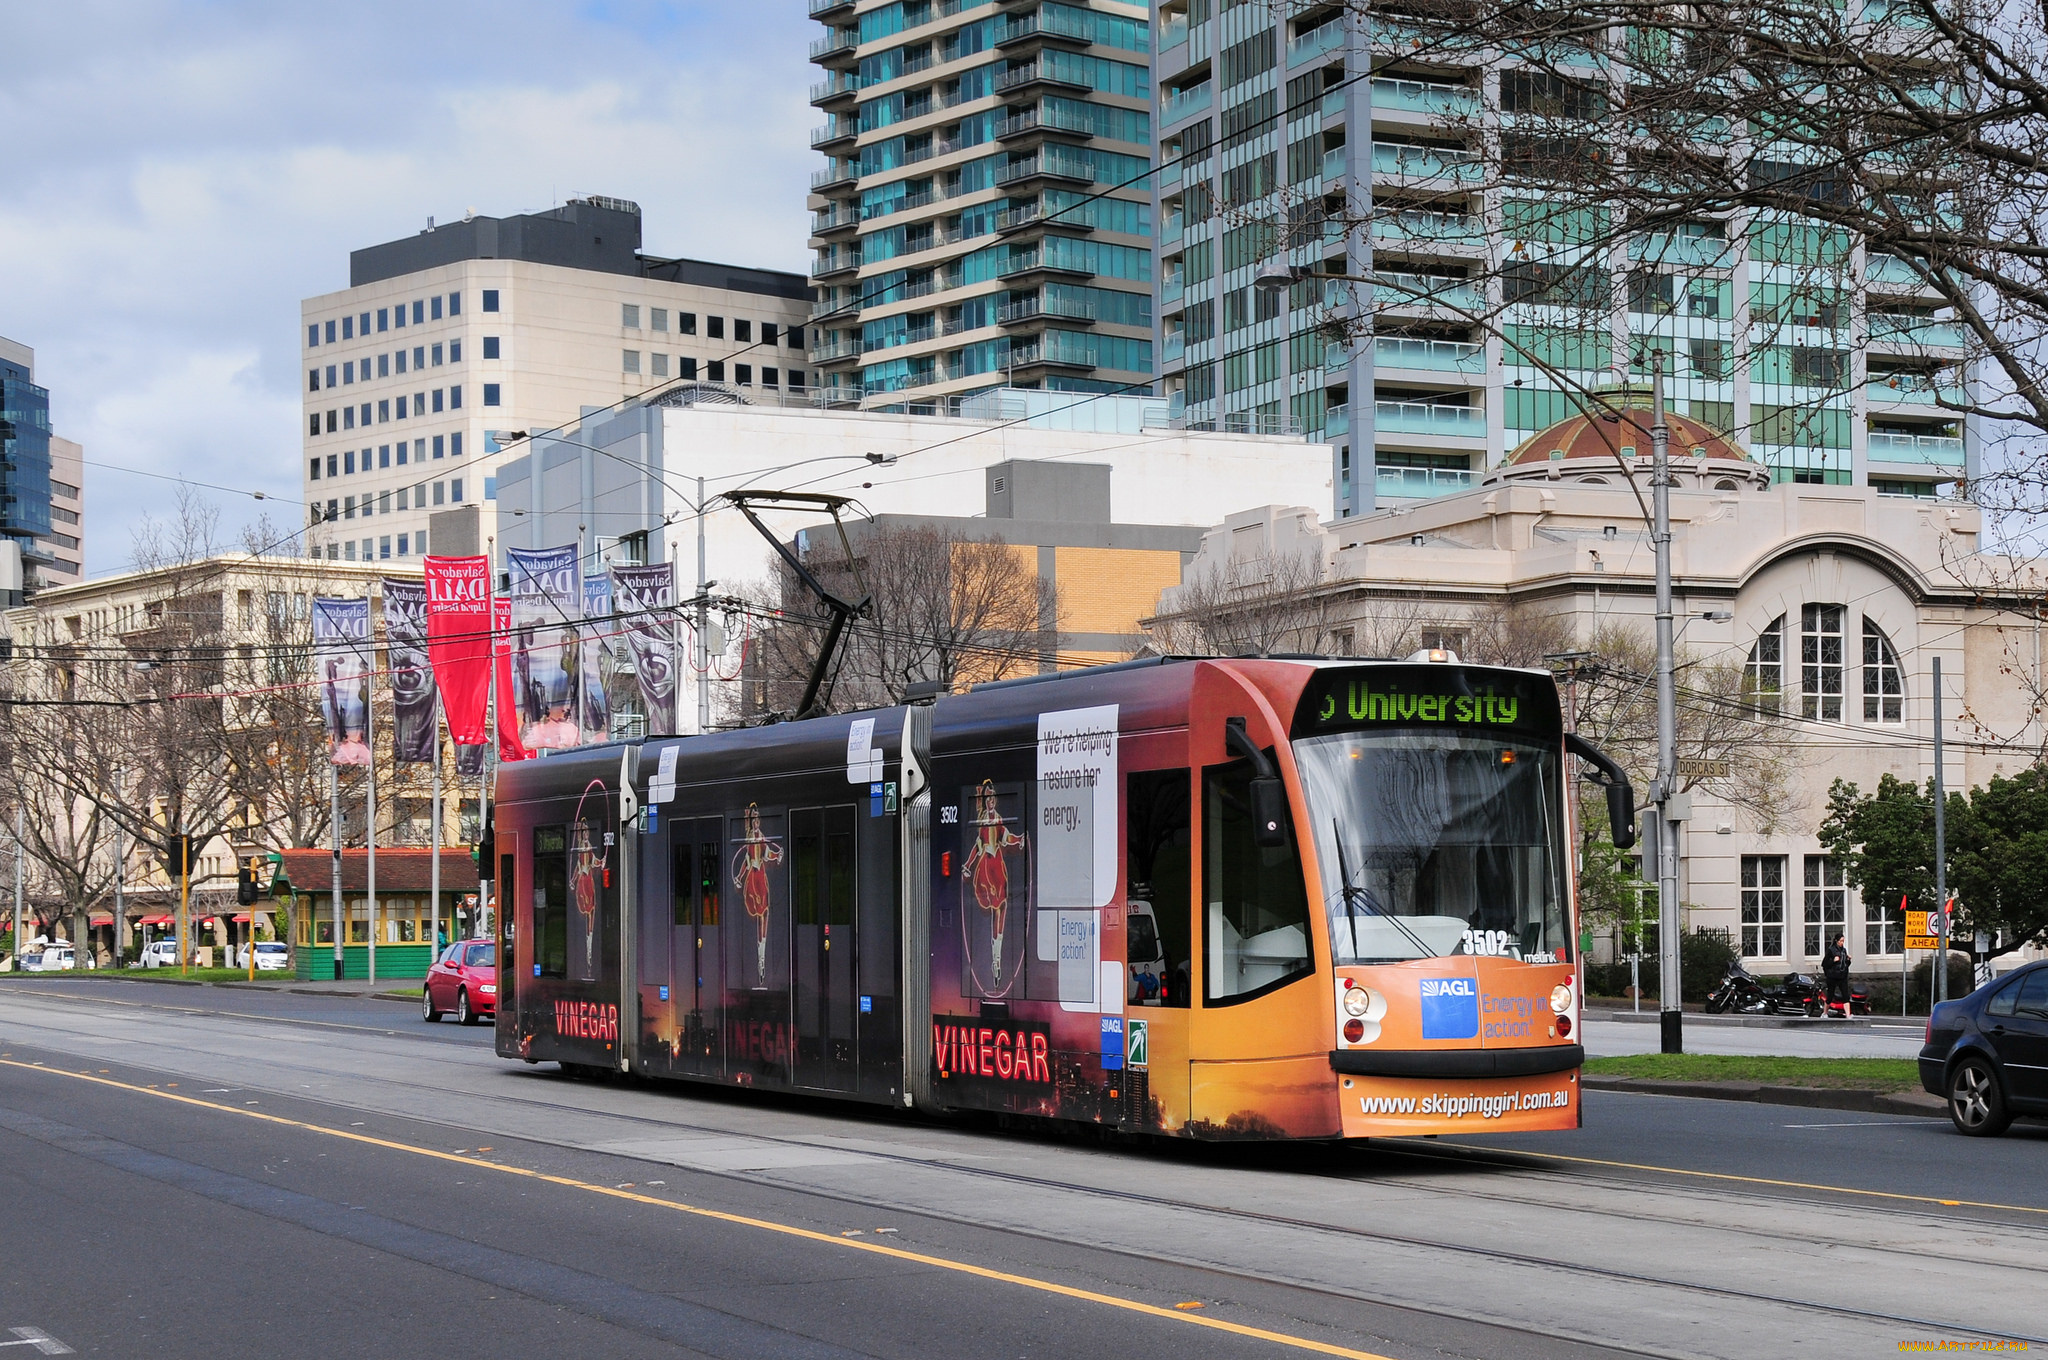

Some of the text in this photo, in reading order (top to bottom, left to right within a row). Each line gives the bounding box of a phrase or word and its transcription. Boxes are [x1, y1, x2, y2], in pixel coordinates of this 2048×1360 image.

[1348, 681, 1518, 723] University
[1043, 726, 1113, 757] We're helping
[1043, 763, 1101, 791] restore her
[1680, 761, 1729, 775] DORCAS ST
[940, 805, 958, 824] 3502
[1043, 805, 1081, 833] energy.
[1061, 917, 1088, 941] Energy
[1462, 929, 1509, 956] 3502
[1438, 979, 1475, 996] AGL
[1482, 992, 1548, 1017] Energy in
[554, 999, 618, 1041] VINEGAR
[1108, 1018, 1123, 1033] AGL
[934, 1023, 1050, 1083] VINEGAR
[1360, 1090, 1569, 1118] www.skippinggirl.com.au
